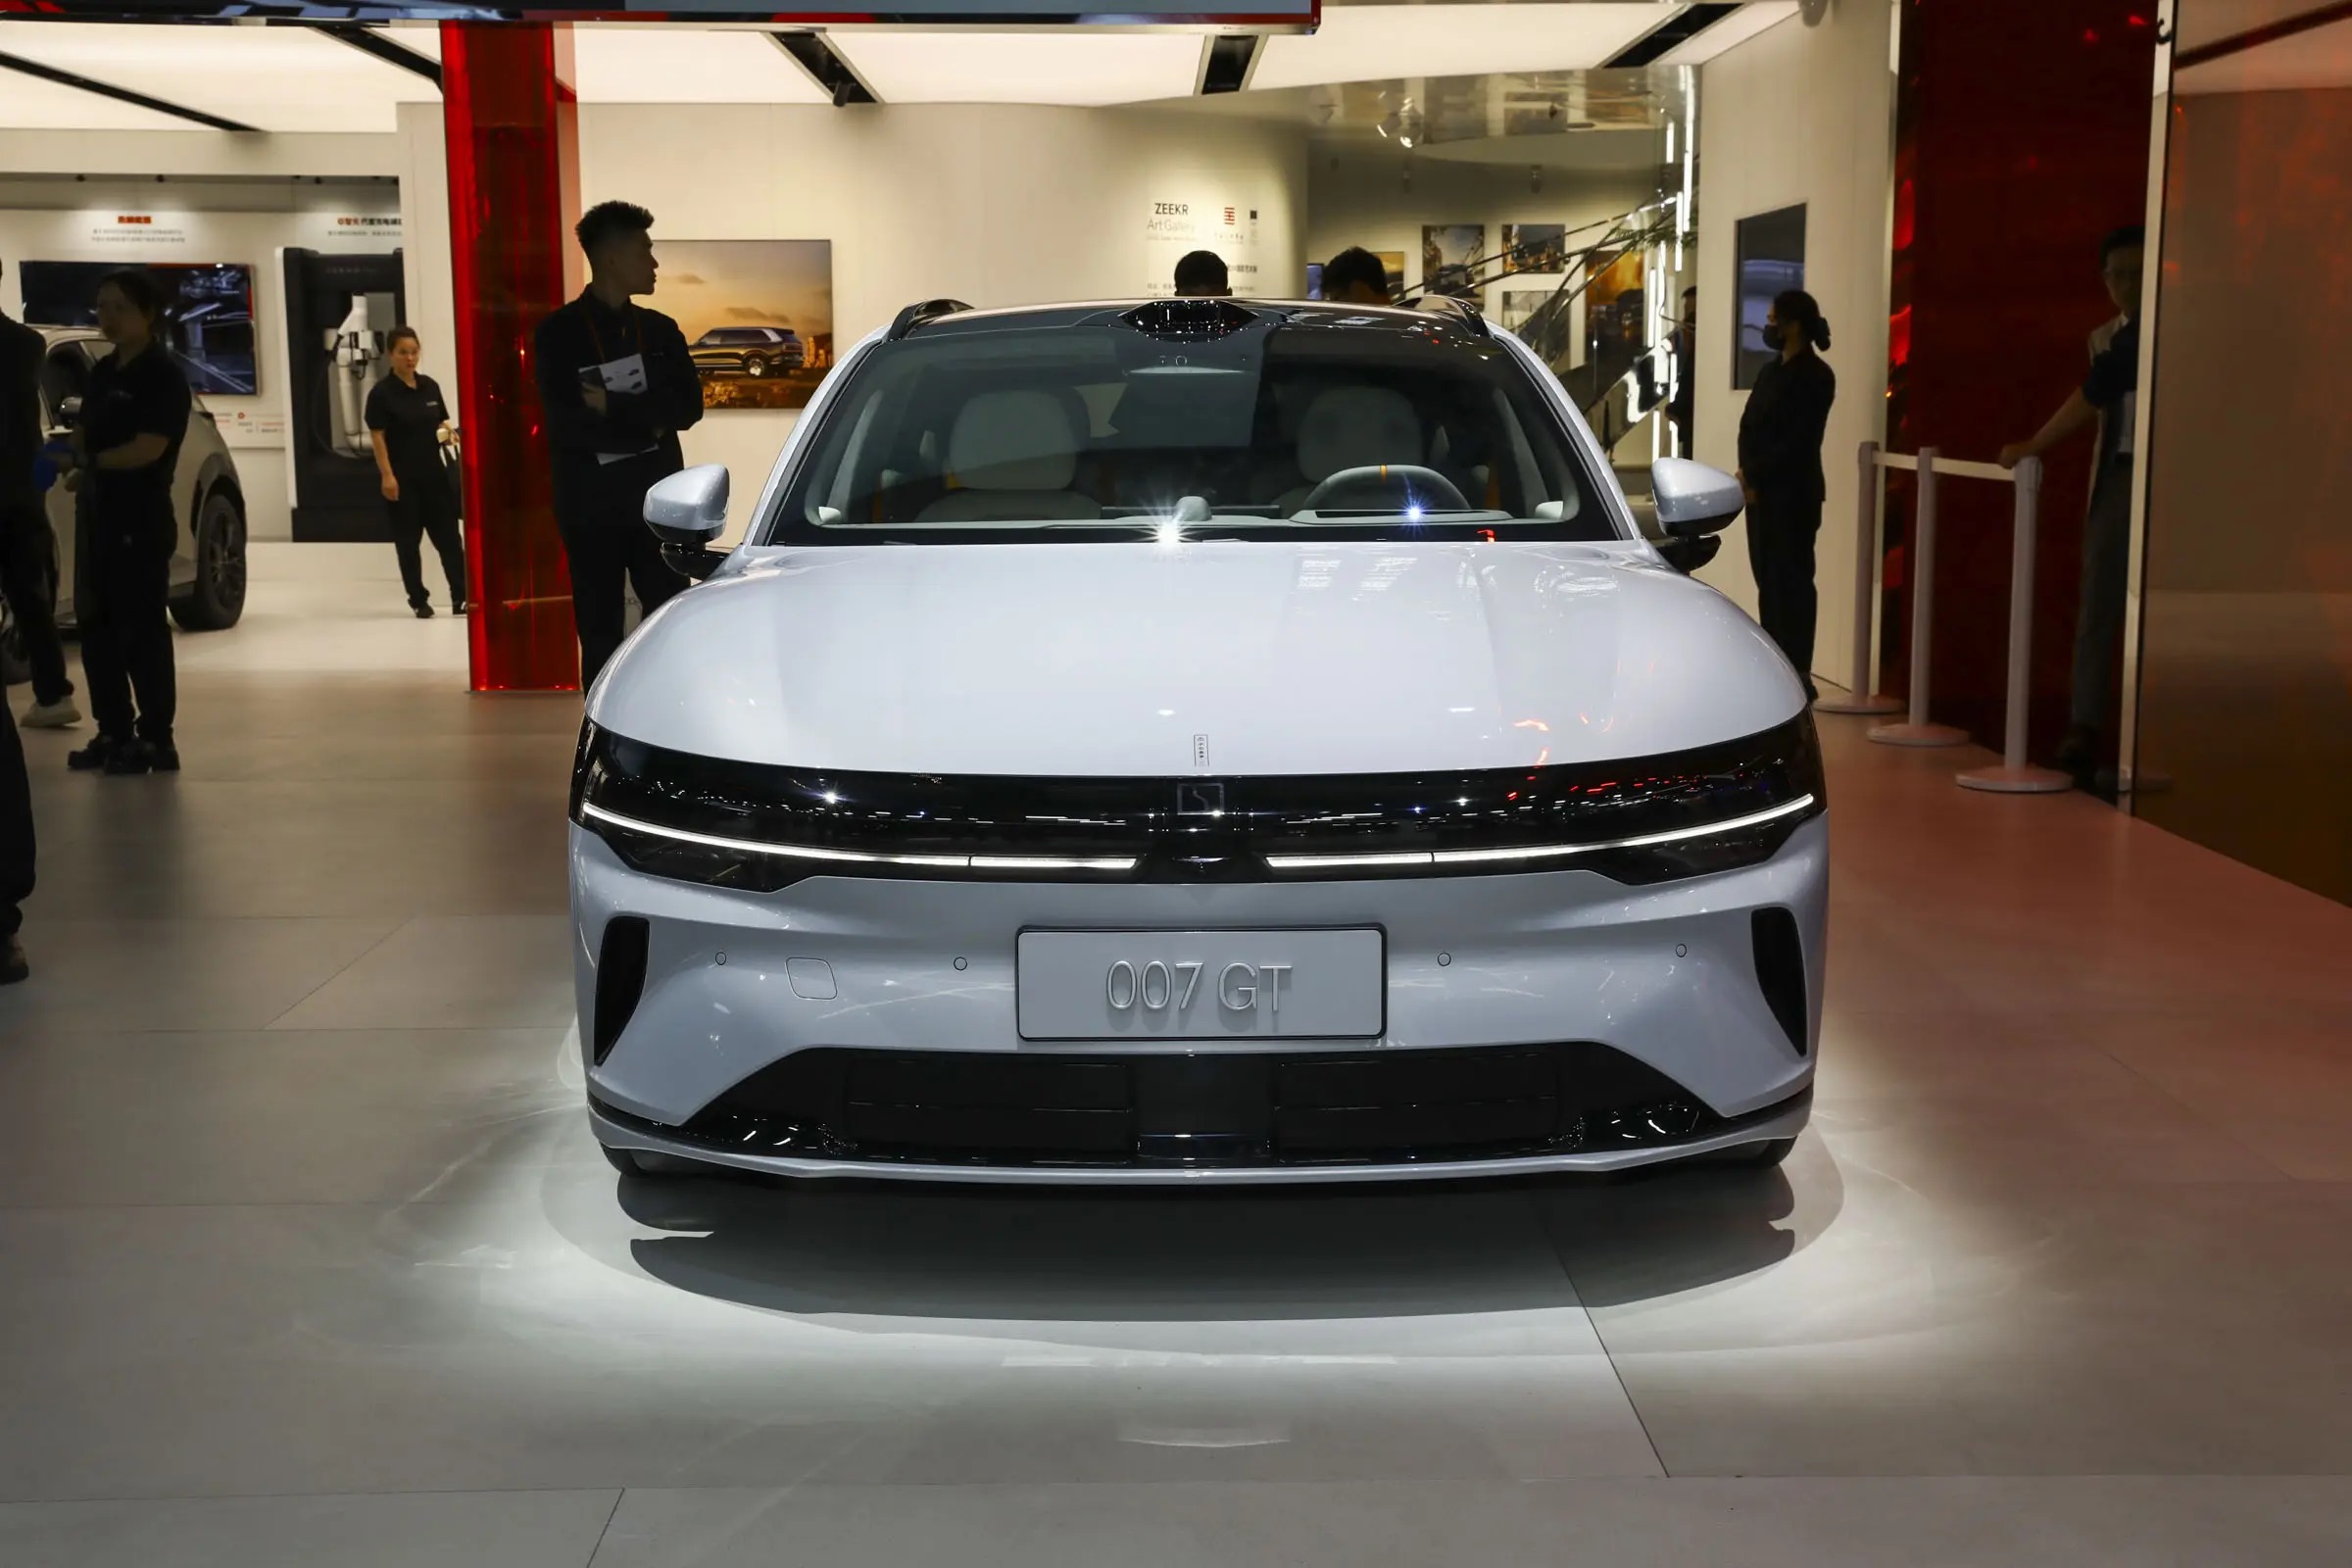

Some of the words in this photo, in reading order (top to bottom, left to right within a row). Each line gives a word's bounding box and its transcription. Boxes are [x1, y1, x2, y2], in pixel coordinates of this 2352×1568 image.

[1154, 202, 1189, 216] ZEEKR
[1147, 218, 1162, 231] Art
[1106, 959, 1204, 1011] 007
[1218, 961, 1293, 1011] GT
